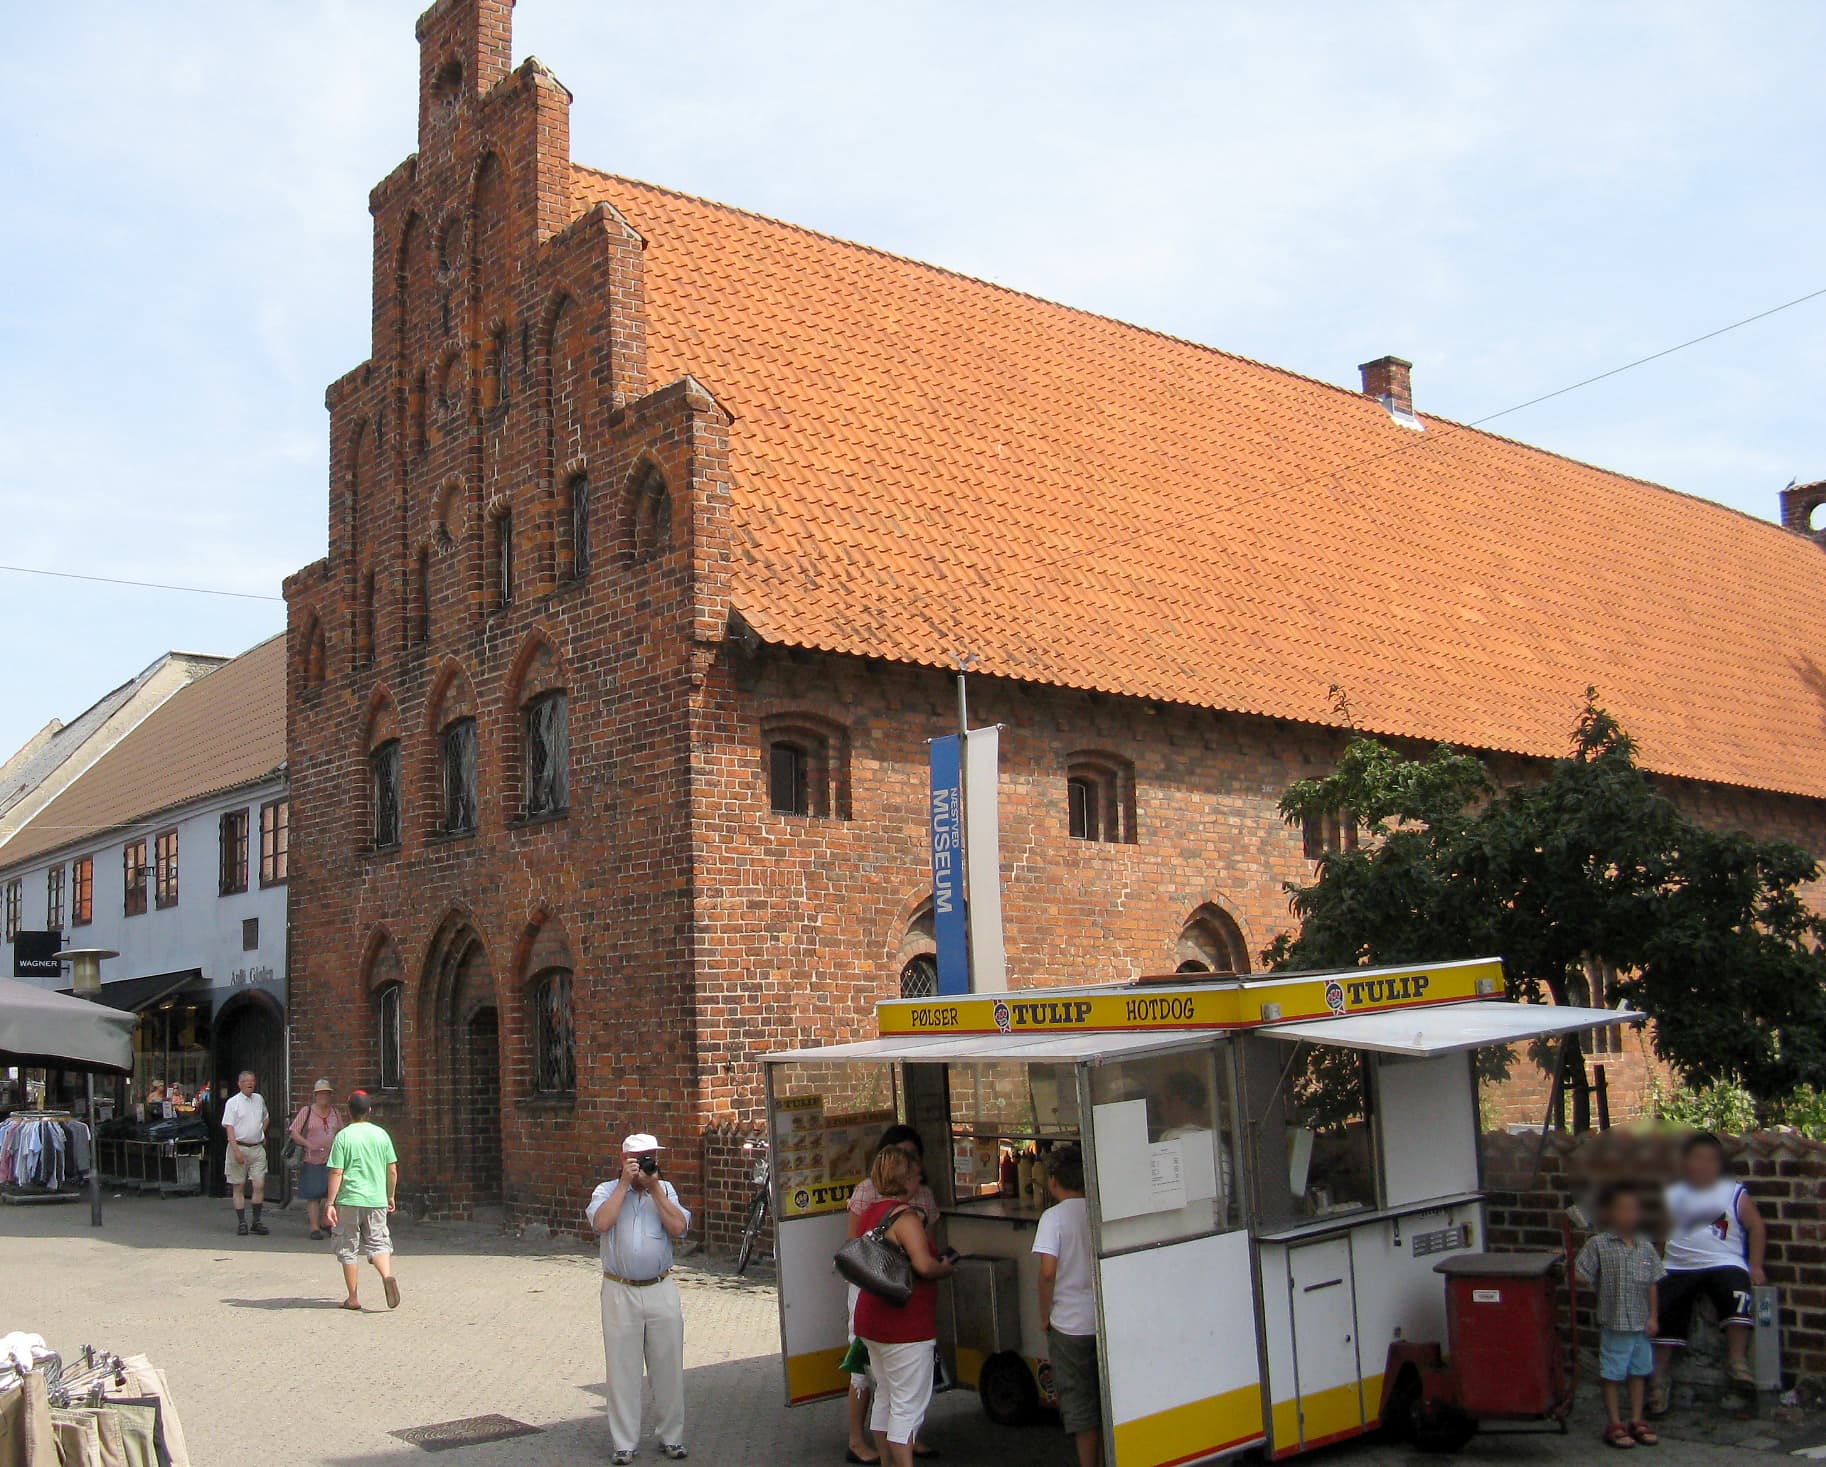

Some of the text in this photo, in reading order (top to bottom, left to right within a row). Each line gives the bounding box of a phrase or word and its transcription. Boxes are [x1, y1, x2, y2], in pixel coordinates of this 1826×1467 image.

[950, 788, 960, 848] NÆSTVED
[933, 789, 953, 913] MUSEUM
[911, 1008, 959, 1027] PØLSER
[1012, 1001, 1093, 1025] TULIP
[1126, 997, 1195, 1021] HOTDOG
[1347, 975, 1430, 1005] TULIP
